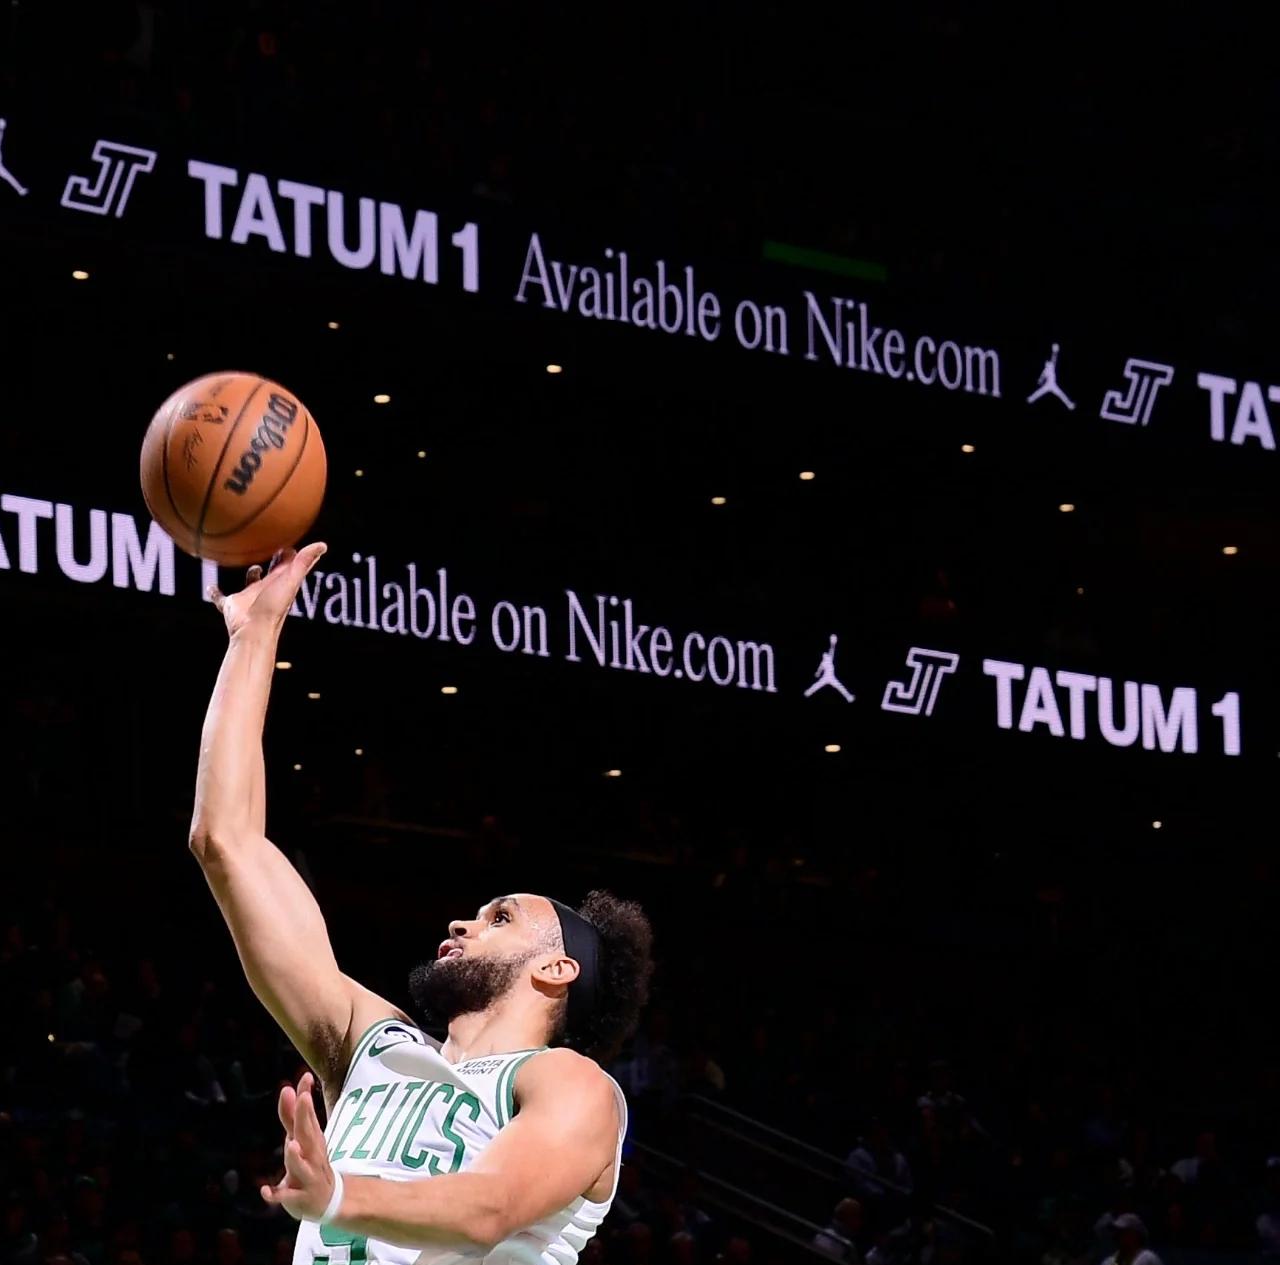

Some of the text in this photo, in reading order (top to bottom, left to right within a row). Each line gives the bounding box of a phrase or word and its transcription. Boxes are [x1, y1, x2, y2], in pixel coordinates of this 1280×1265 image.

[188, 160, 438, 285] TATUM
[452, 223, 479, 293] 1
[515, 233, 721, 341] Available
[735, 301, 788, 355] on
[805, 292, 1001, 398] Nike.com
[224, 393, 298, 496] Wilson
[288, 546, 477, 646] vailable
[492, 601, 550, 658] on
[566, 590, 778, 693] Nike.com
[983, 659, 1199, 754] TATUM
[1212, 692, 1241, 756] 1
[463, 1059, 505, 1069] VISTA
[329, 1081, 481, 1176] CELTICS
